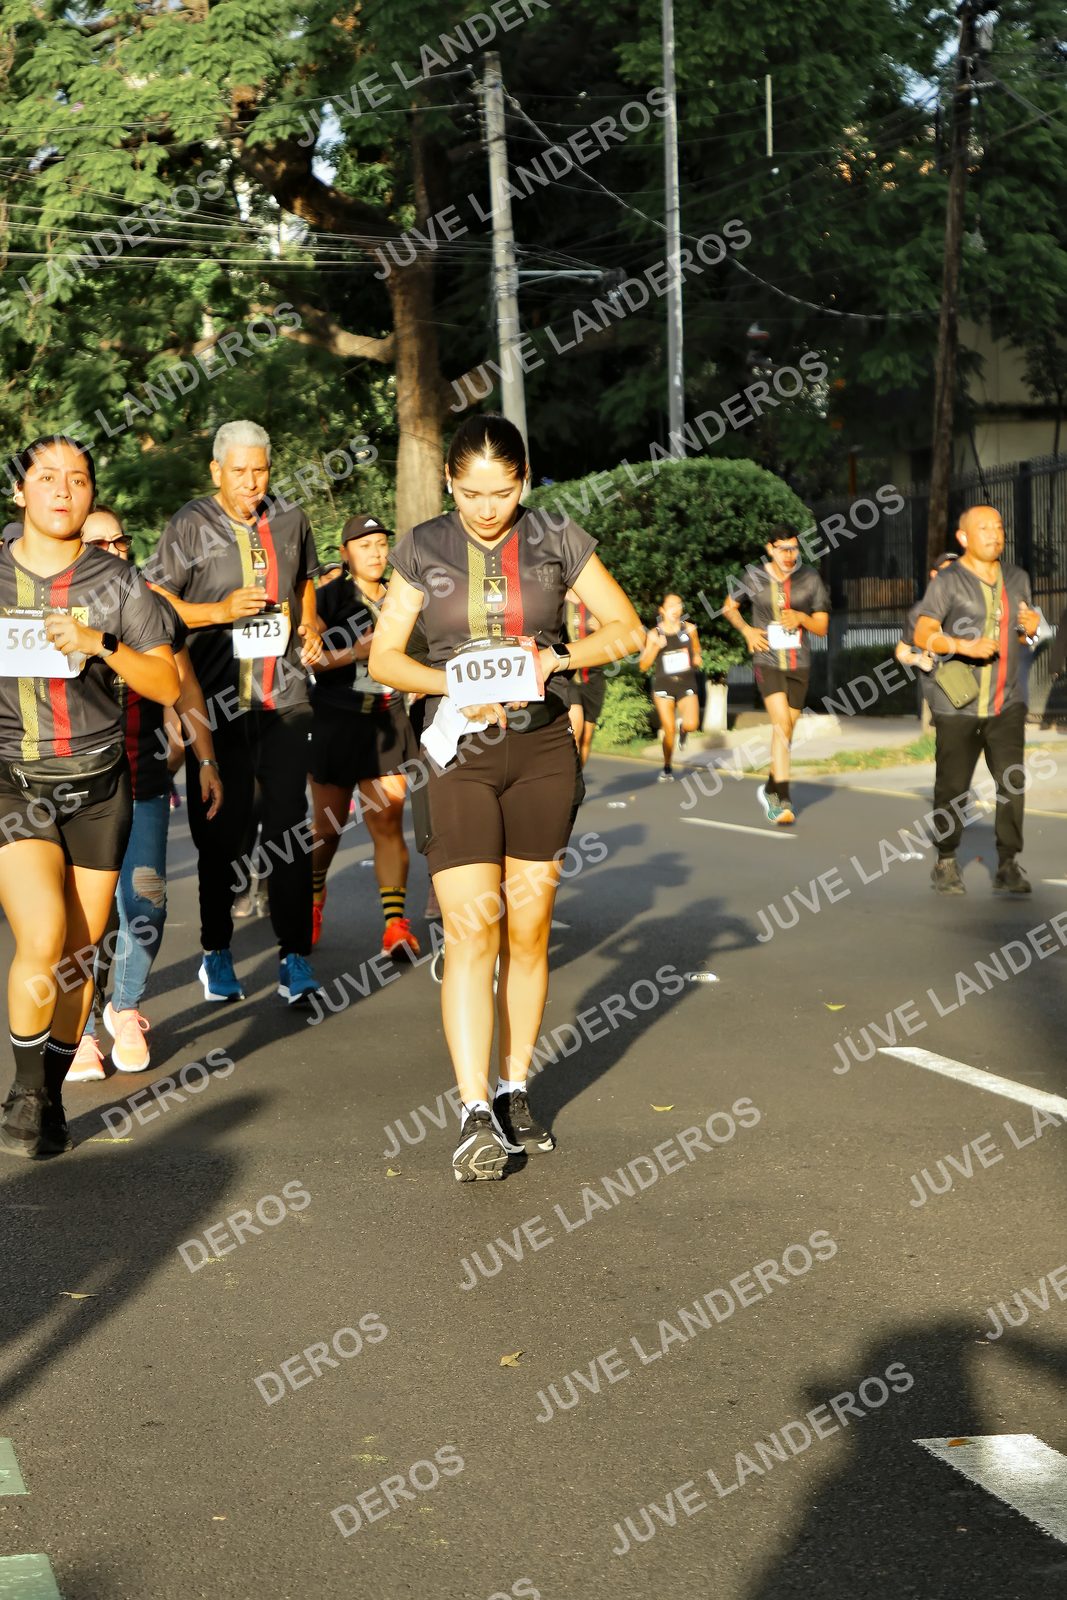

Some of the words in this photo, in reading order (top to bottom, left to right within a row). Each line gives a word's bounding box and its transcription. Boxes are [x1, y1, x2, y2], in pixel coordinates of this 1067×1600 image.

[6, 628, 49, 650] 569
[242, 621, 281, 639] 4123
[451, 655, 527, 683] 10597
